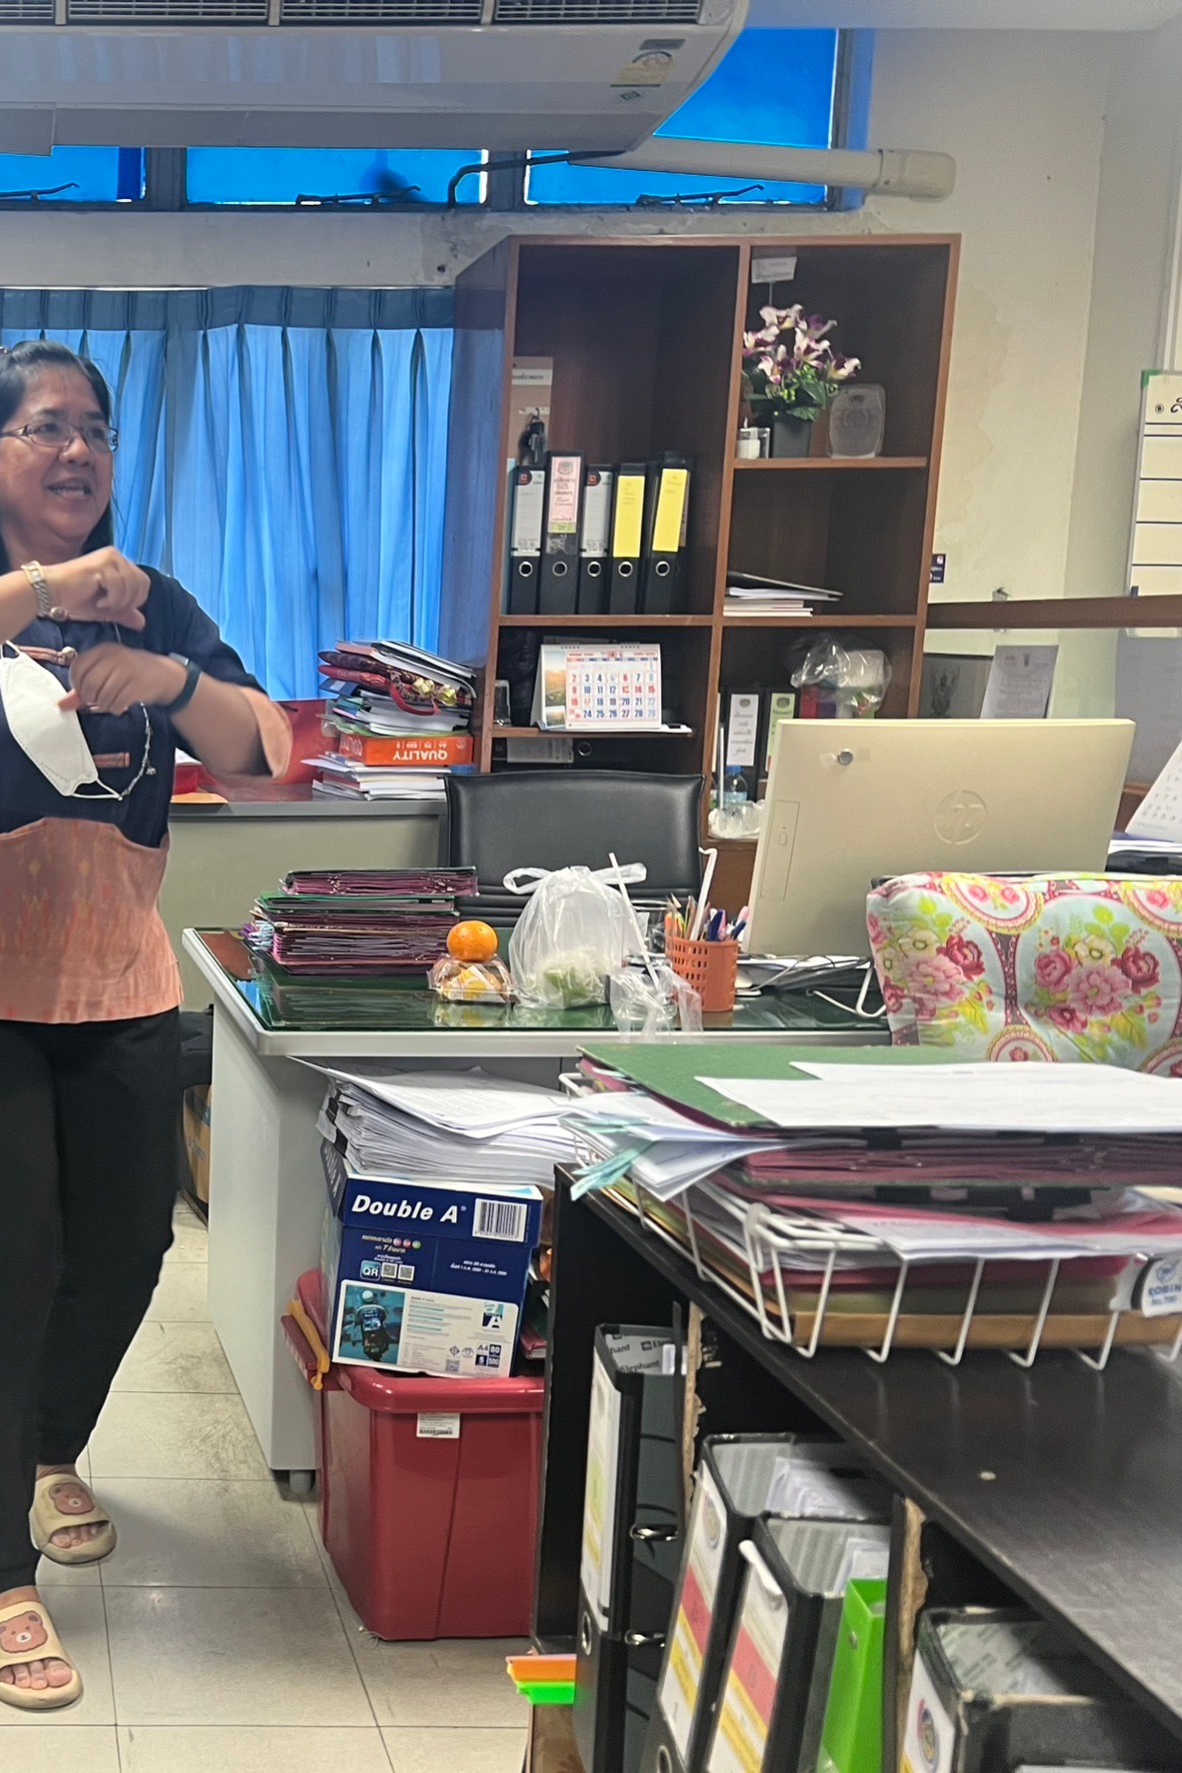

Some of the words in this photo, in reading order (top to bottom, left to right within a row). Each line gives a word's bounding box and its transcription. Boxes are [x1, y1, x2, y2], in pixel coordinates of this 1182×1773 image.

[572, 674, 577, 682] 2
[585, 674, 590, 682] 3
[597, 674, 602, 682] 4
[636, 674, 641, 682] 7
[584, 686, 591, 694] 10
[597, 686, 603, 694] 11
[609, 686, 616, 694] 12
[622, 698, 630, 706] 20
[635, 698, 642, 706] 21
[583, 710, 592, 718] 24
[596, 710, 605, 718] 25
[609, 710, 617, 718] 26
[622, 710, 630, 718] 27
[393, 750, 448, 760] QUALITY
[351, 1195, 434, 1221] Double
[440, 1205, 458, 1223] A
[362, 1267, 379, 1277] QR
